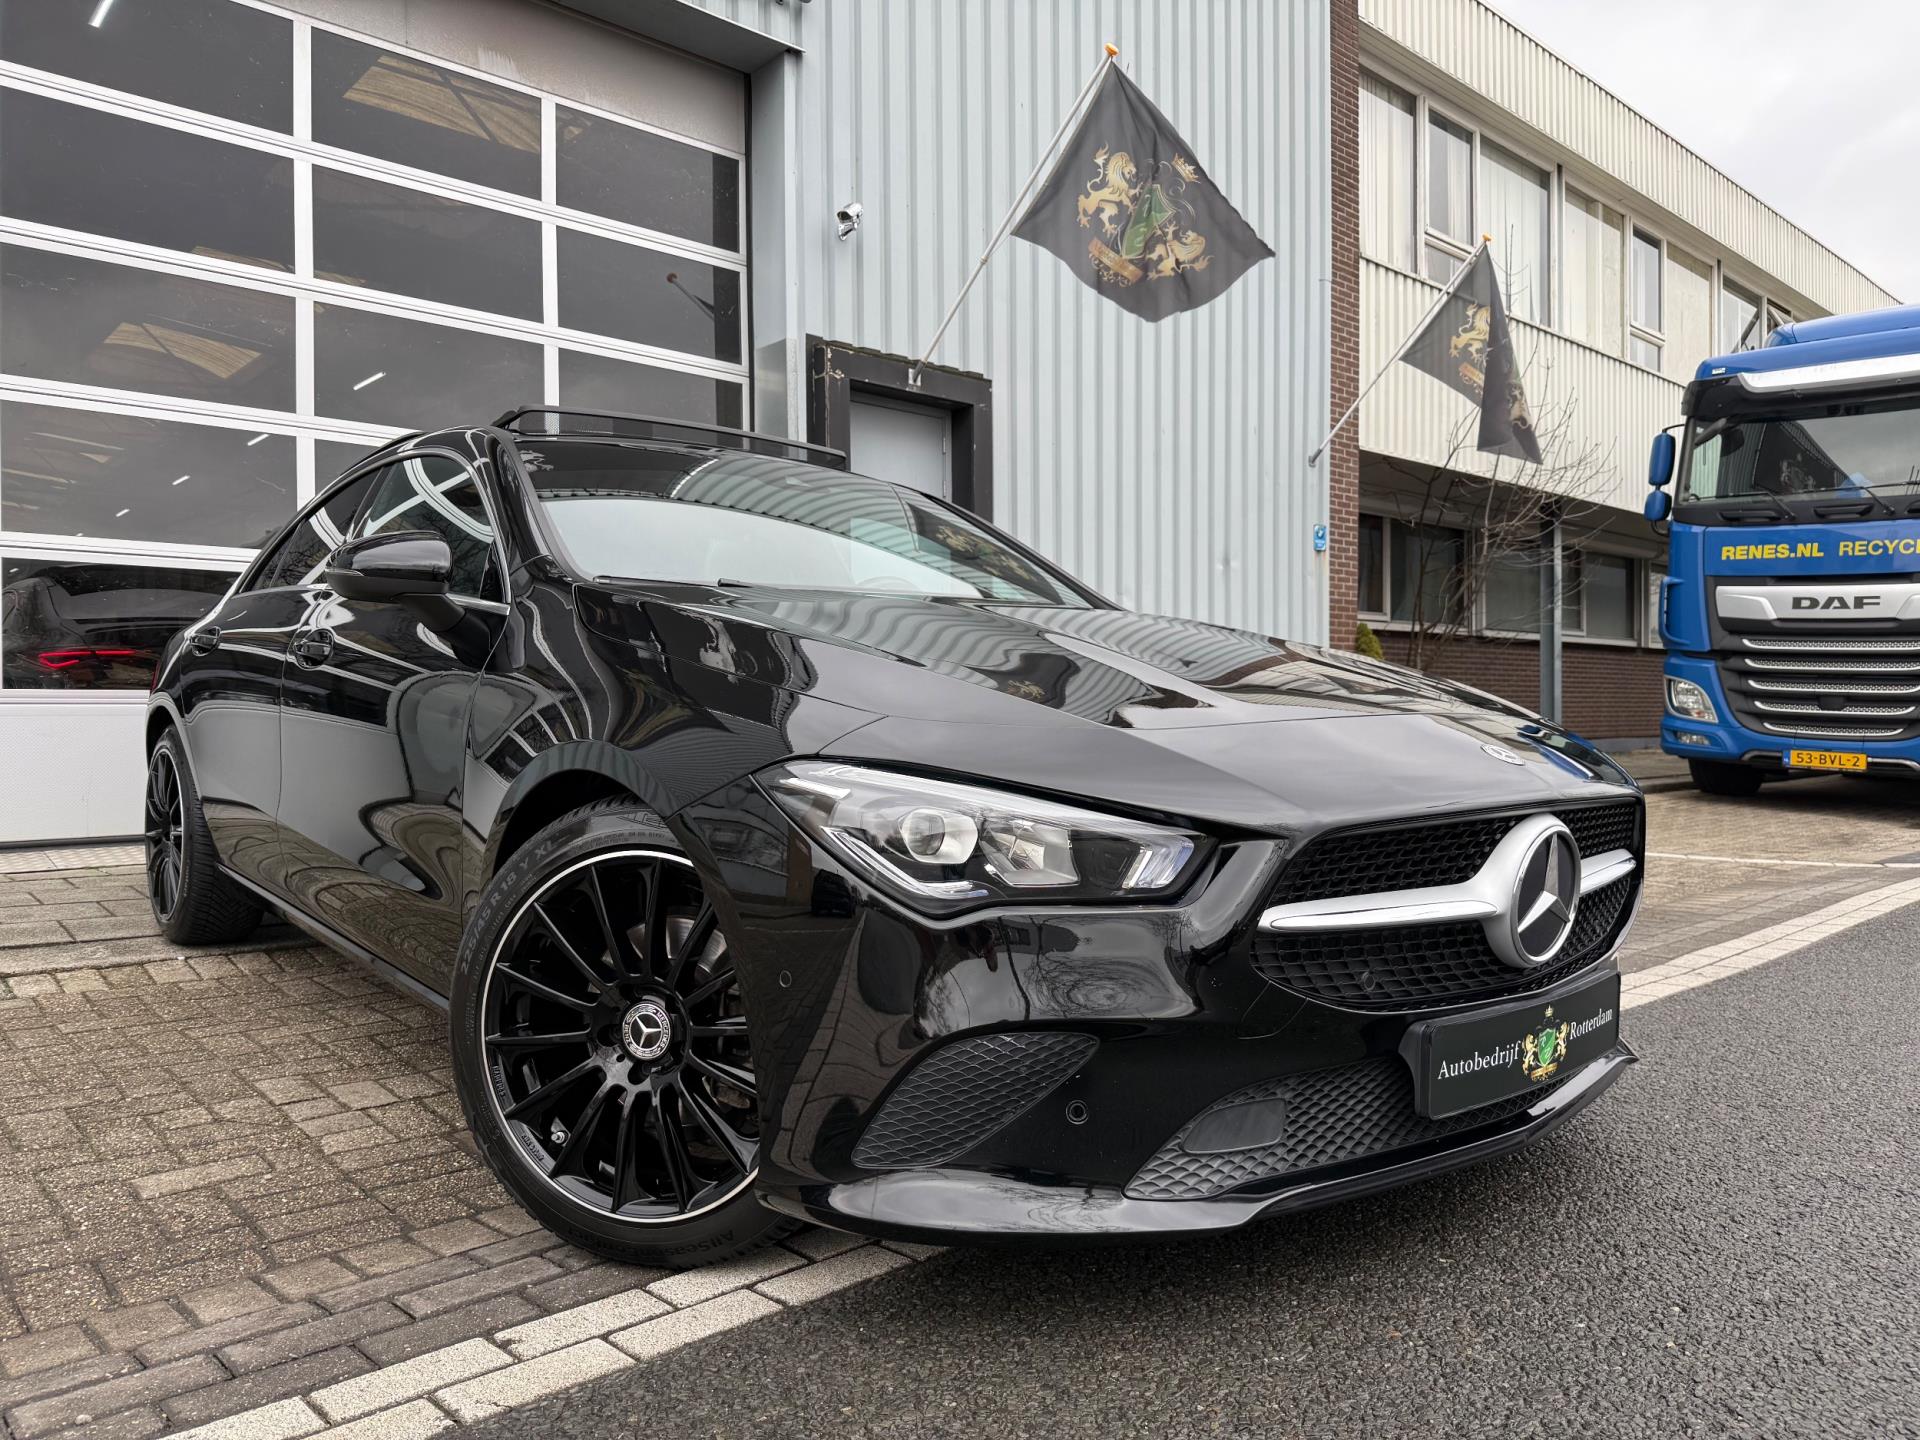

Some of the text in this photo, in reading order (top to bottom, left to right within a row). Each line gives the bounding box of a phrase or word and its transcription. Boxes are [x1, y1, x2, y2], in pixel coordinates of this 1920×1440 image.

[1721, 542, 1824, 561] RENES.NL
[1792, 595, 1881, 610] DAF
[1796, 752, 1860, 768] 53-BVL-2
[1438, 1040, 1522, 1080] Autobedrijf
[1569, 1008, 1613, 1040] Rotterdam
